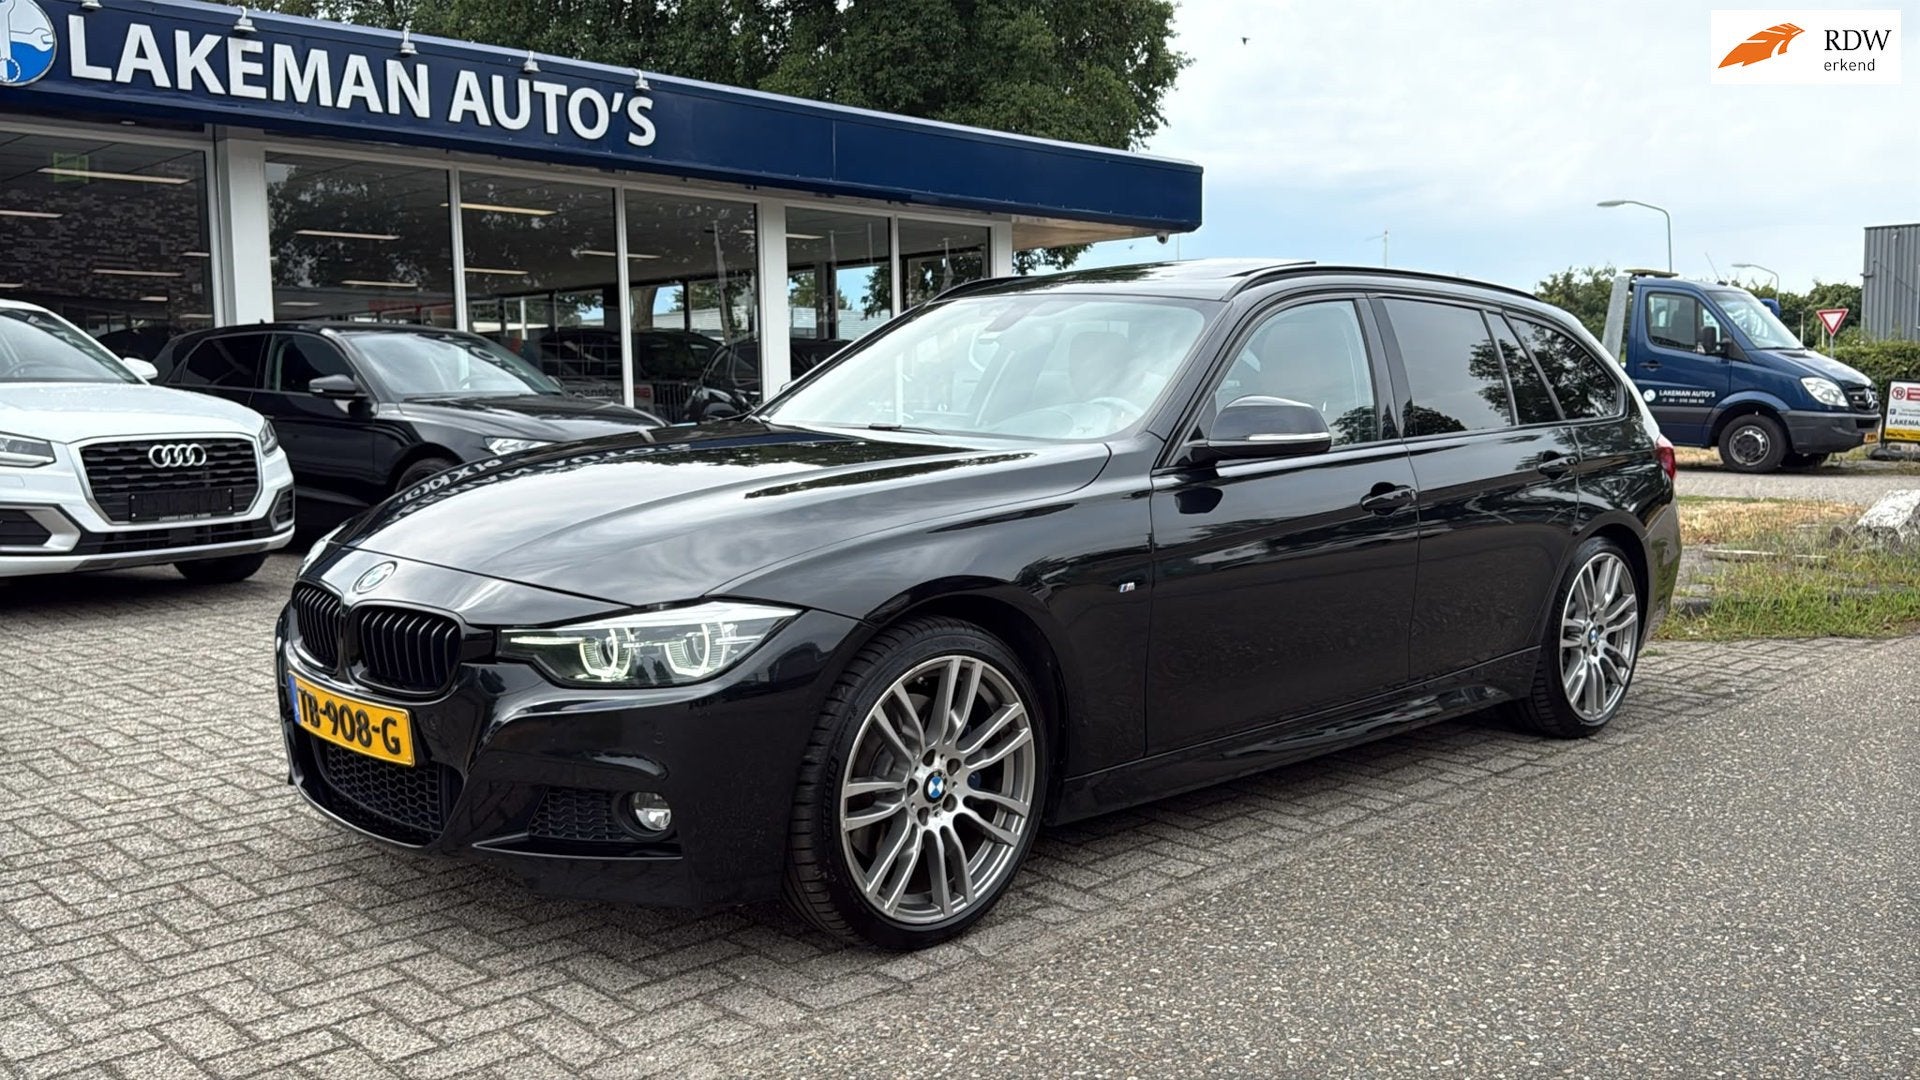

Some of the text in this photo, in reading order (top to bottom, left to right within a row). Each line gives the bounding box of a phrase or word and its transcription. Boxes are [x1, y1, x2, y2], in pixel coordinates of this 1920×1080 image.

[68, 14, 657, 147] LAKEMAN AUTO'S
[1658, 389, 1716, 398] LAKEMAN AUTO'S
[1889, 418, 1920, 426] LAKEMA
[298, 686, 402, 756] TB-908-G
